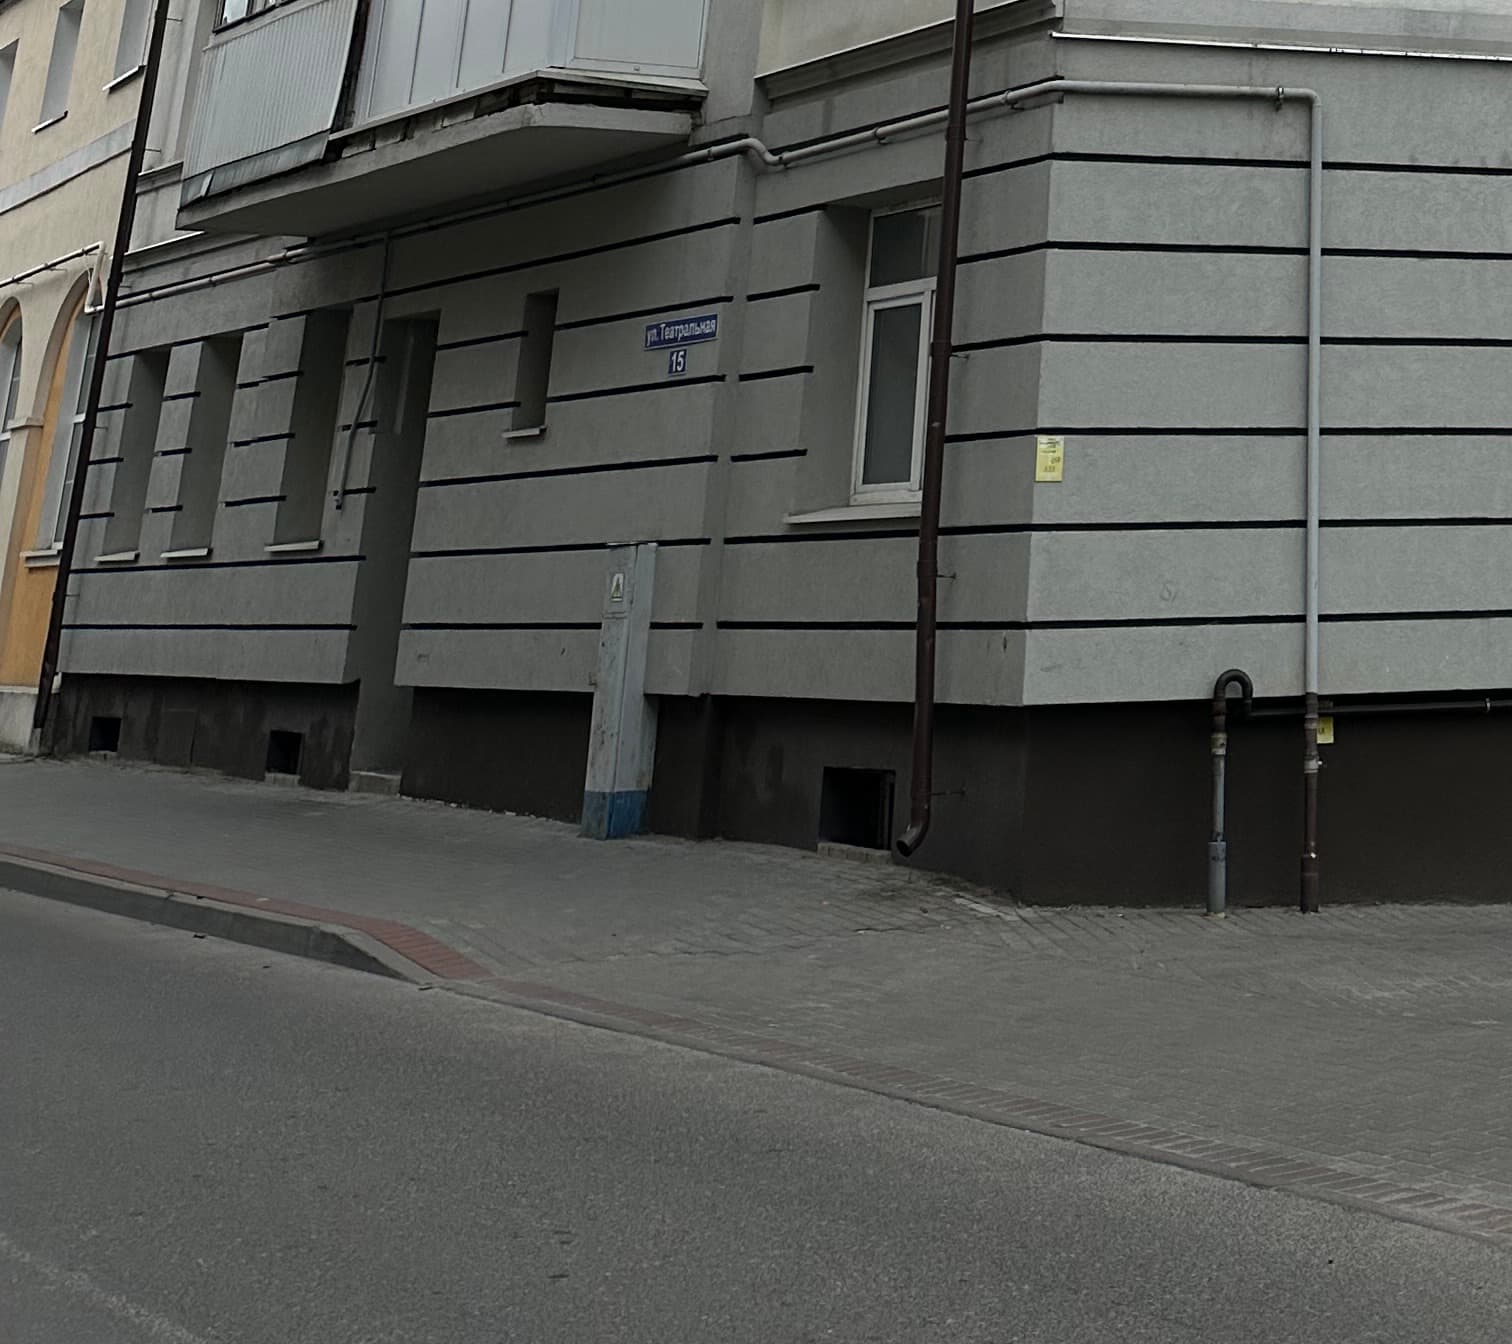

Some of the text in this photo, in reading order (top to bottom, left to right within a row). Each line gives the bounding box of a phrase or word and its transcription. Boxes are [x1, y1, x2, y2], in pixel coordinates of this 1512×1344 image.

[646, 319, 716, 346] ул. Театральная
[671, 351, 684, 372] 15
